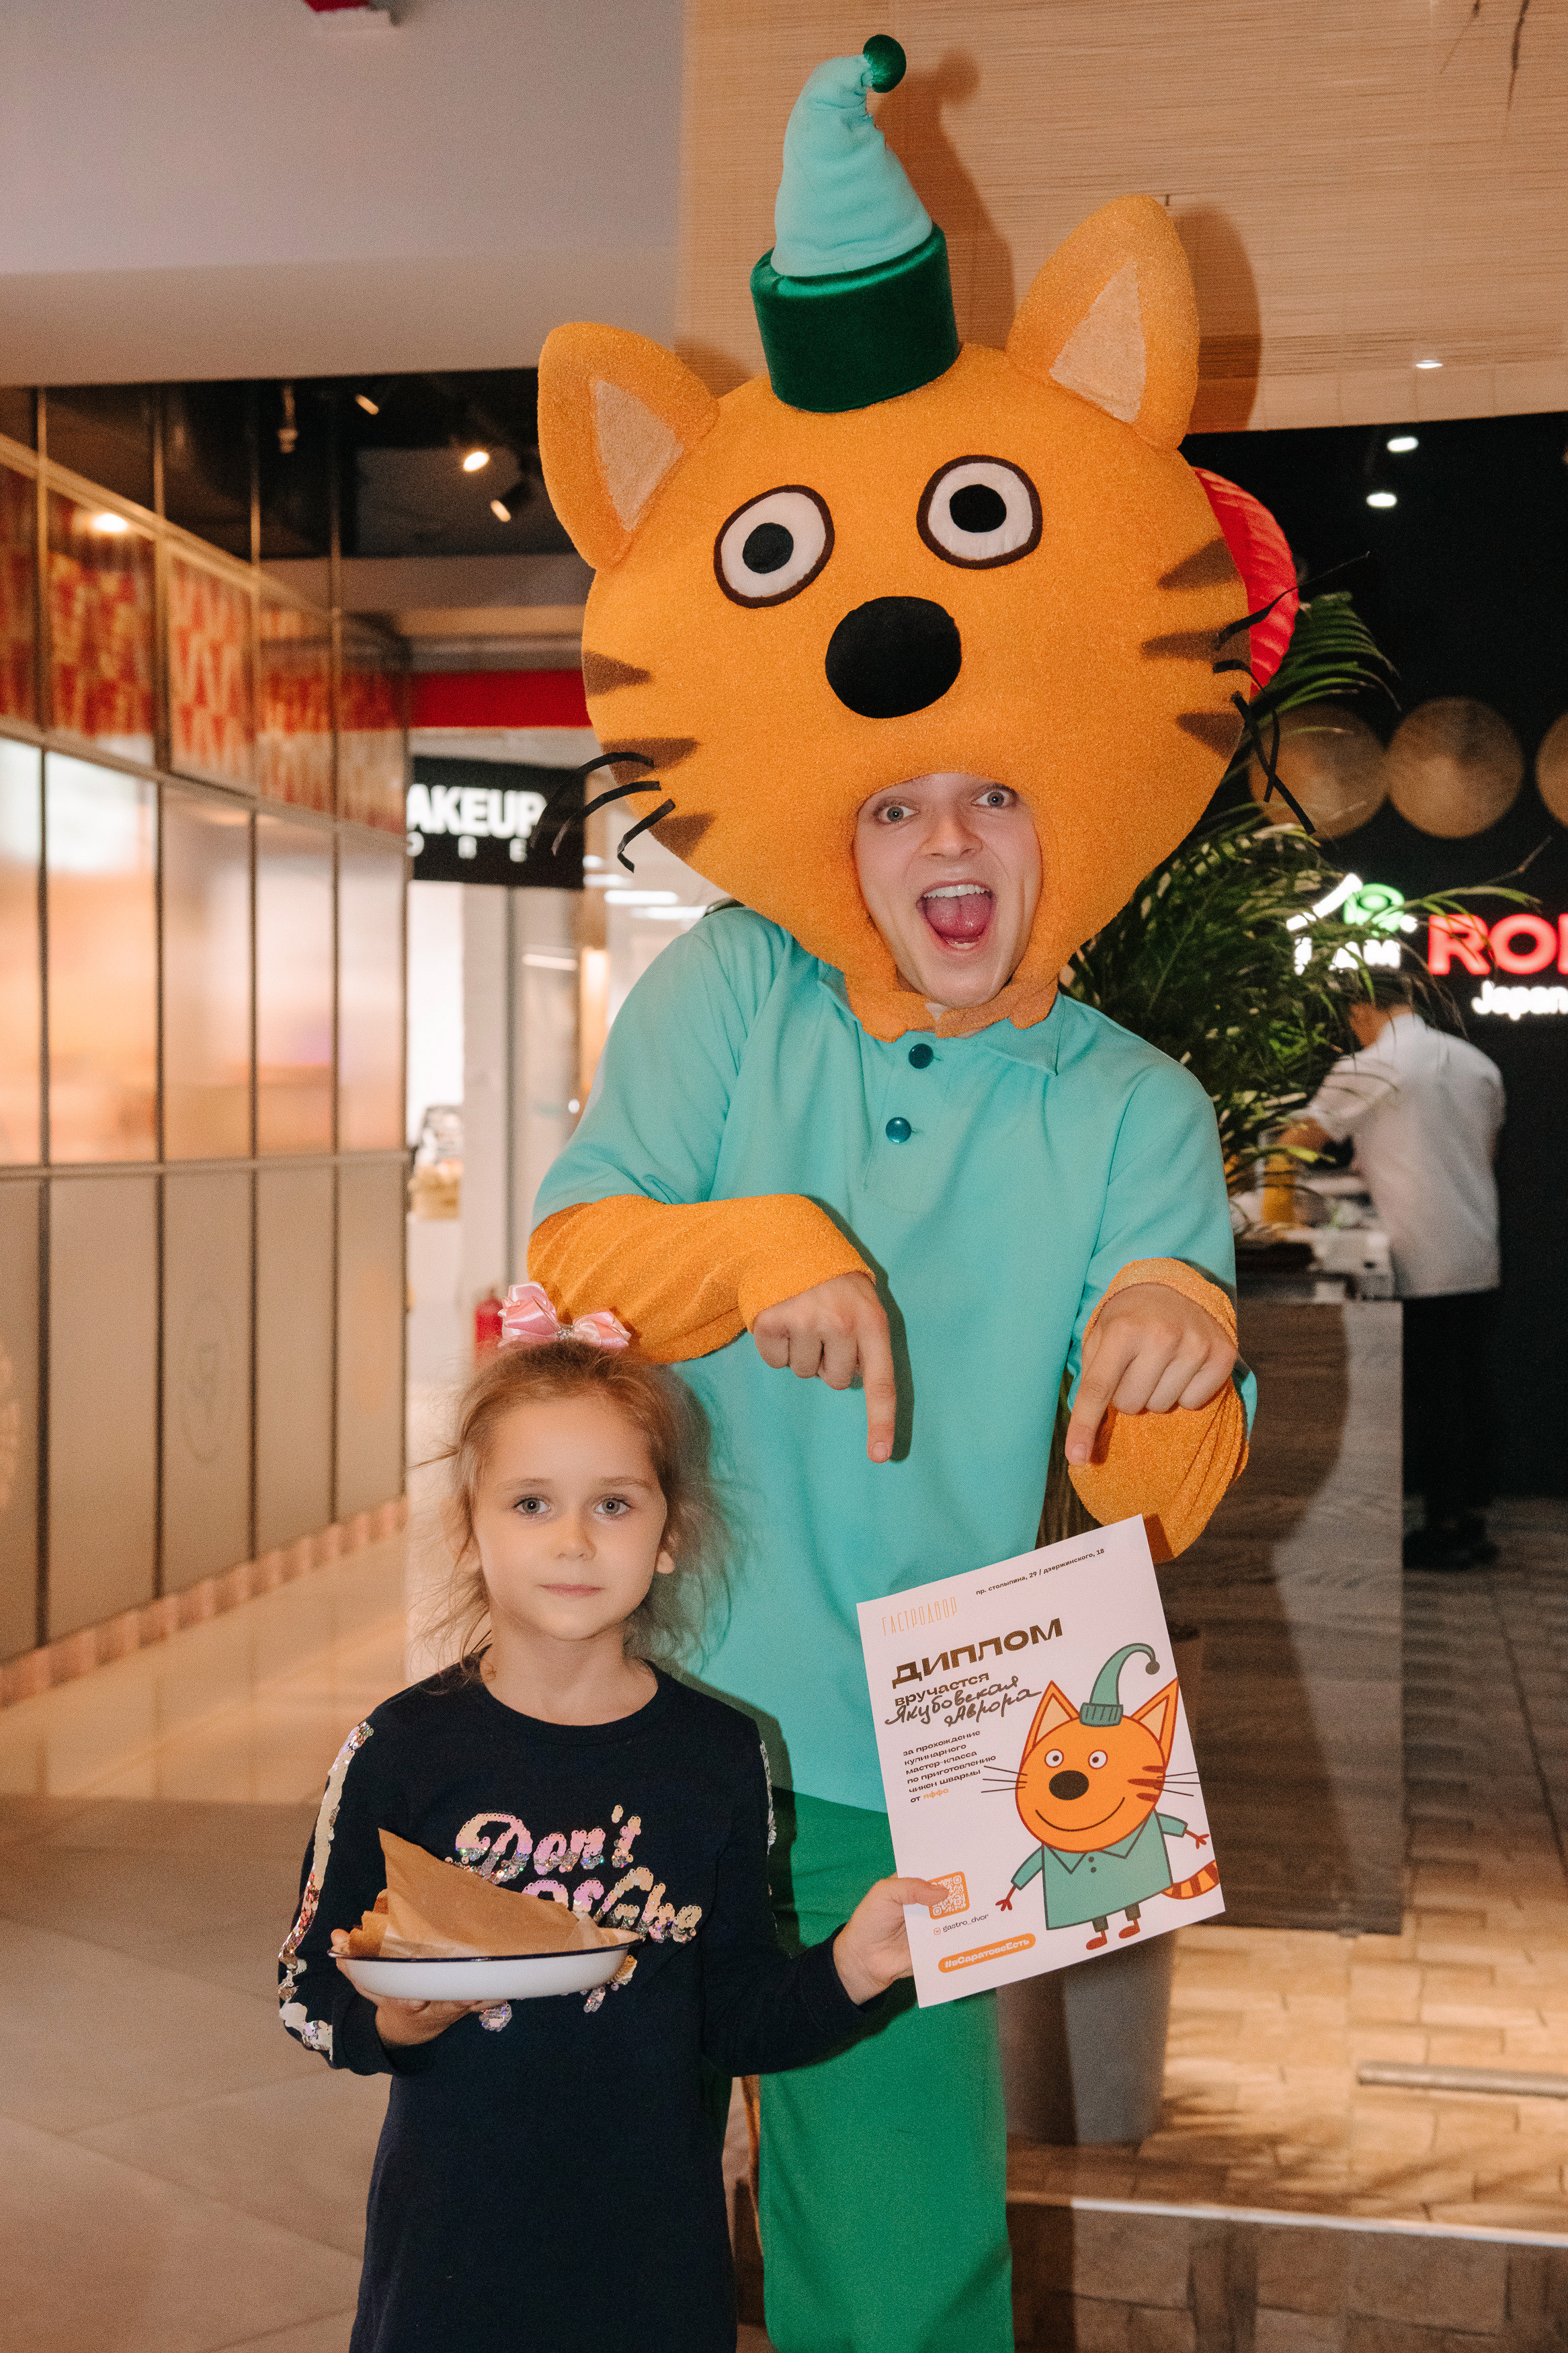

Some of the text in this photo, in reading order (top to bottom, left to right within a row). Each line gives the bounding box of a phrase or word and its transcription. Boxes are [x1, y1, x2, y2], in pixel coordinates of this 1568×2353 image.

[988, 1575, 1028, 1591] столыпина,
[1044, 1552, 1096, 1574] дзержинского,
[882, 1597, 958, 1636] ГАСТРОДВОР
[892, 1618, 1063, 1689] ДИПЛОМ
[884, 1675, 1019, 1724] Якубовская
[895, 1673, 989, 1706] вручается
[944, 1689, 1042, 1727] Аврора
[904, 1744, 966, 1765] кулинарного
[916, 1730, 981, 1752] прохождение
[906, 1751, 977, 1775] мастер-класса
[921, 1755, 996, 1780] приготовлению
[909, 1769, 981, 1793] чикен швармы
[923, 1788, 949, 1799] яффо
[445, 1804, 641, 1884] Don't
[942, 1914, 989, 1932] gastro_dvor
[944, 1939, 1030, 1968] #вСаратовеЕсть
